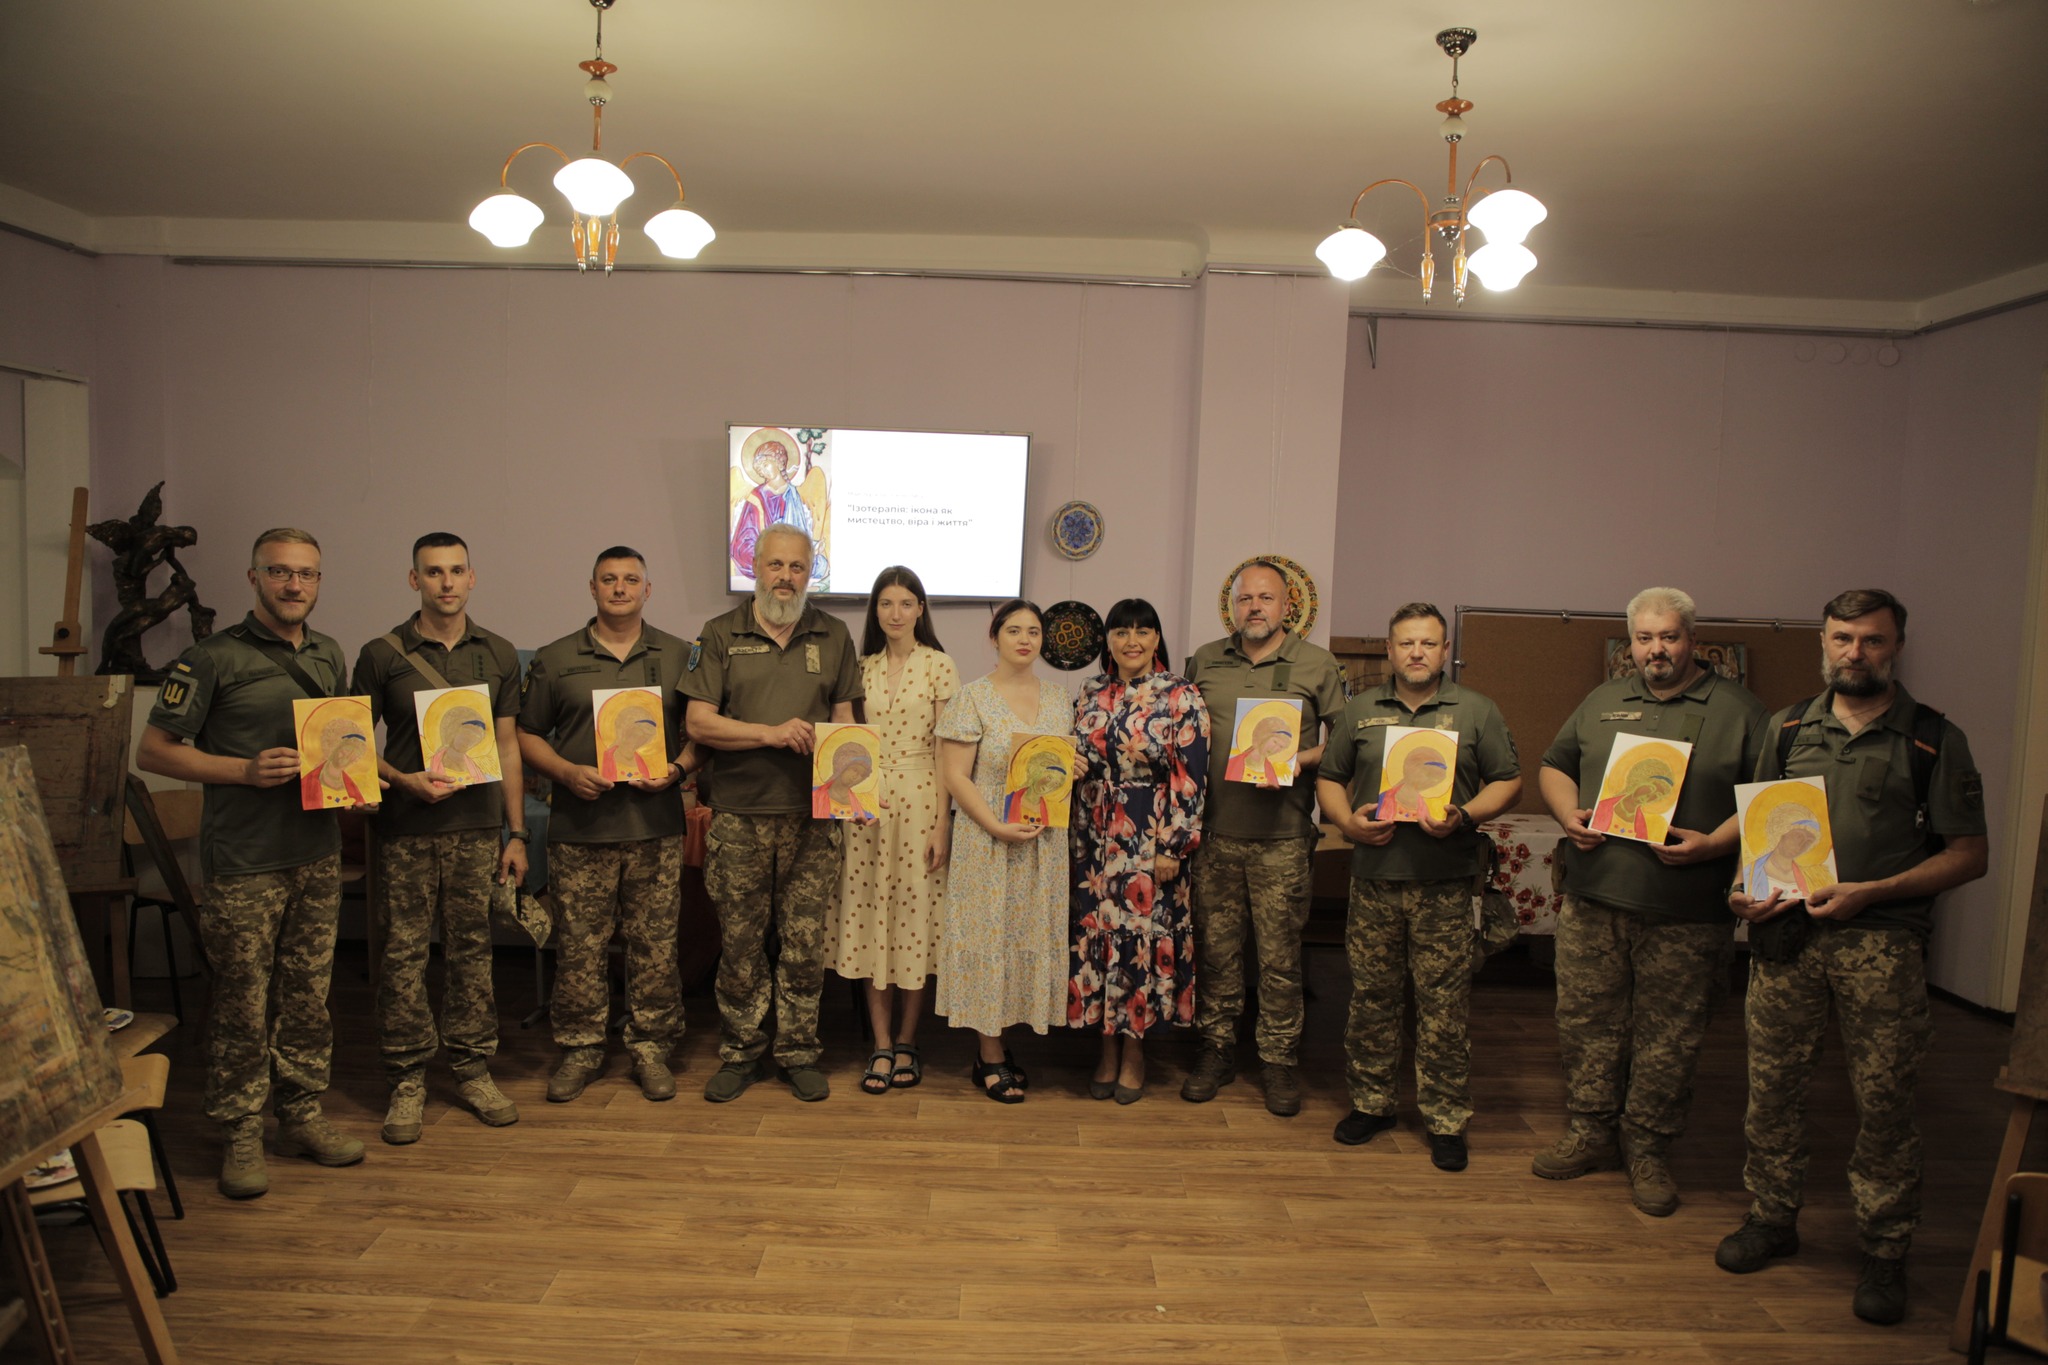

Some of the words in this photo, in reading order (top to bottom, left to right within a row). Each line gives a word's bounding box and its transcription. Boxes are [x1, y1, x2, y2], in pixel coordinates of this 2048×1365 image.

[911, 505, 939, 514] ікона
[847, 517, 905, 526] мистецтво,
[908, 517, 929, 527] віра
